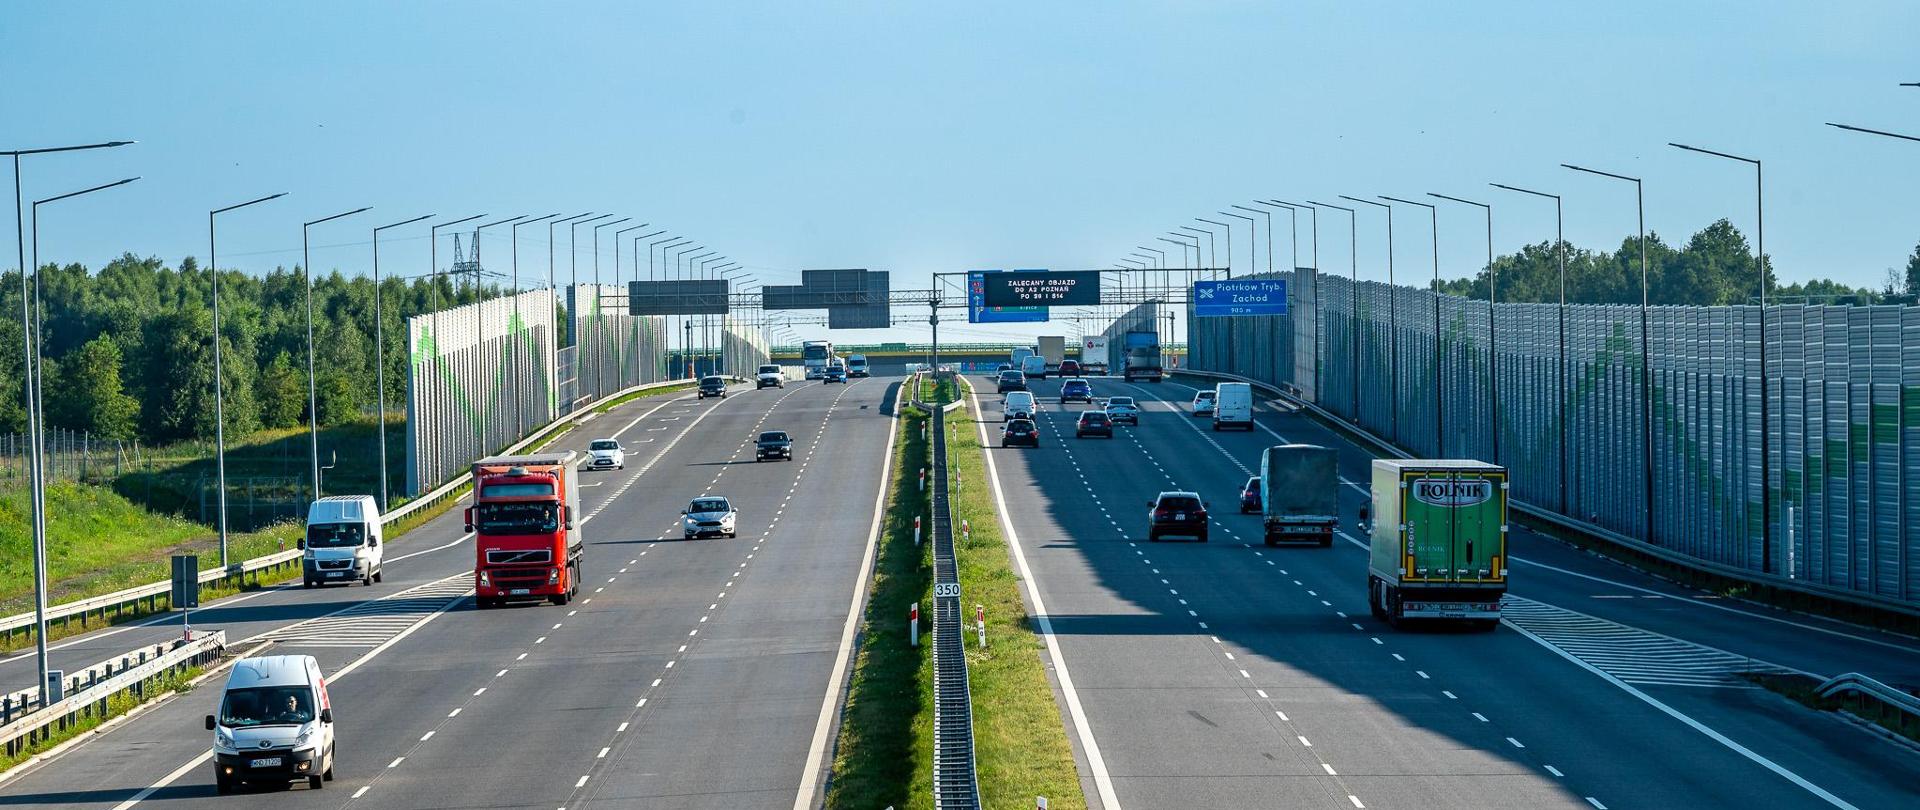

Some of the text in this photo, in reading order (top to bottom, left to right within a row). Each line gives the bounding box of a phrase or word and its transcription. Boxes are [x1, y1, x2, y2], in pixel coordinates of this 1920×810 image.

[1261, 282, 1283, 292] Tryb.
[1420, 484, 1484, 499] ROLNIK
[936, 585, 959, 595] 350
